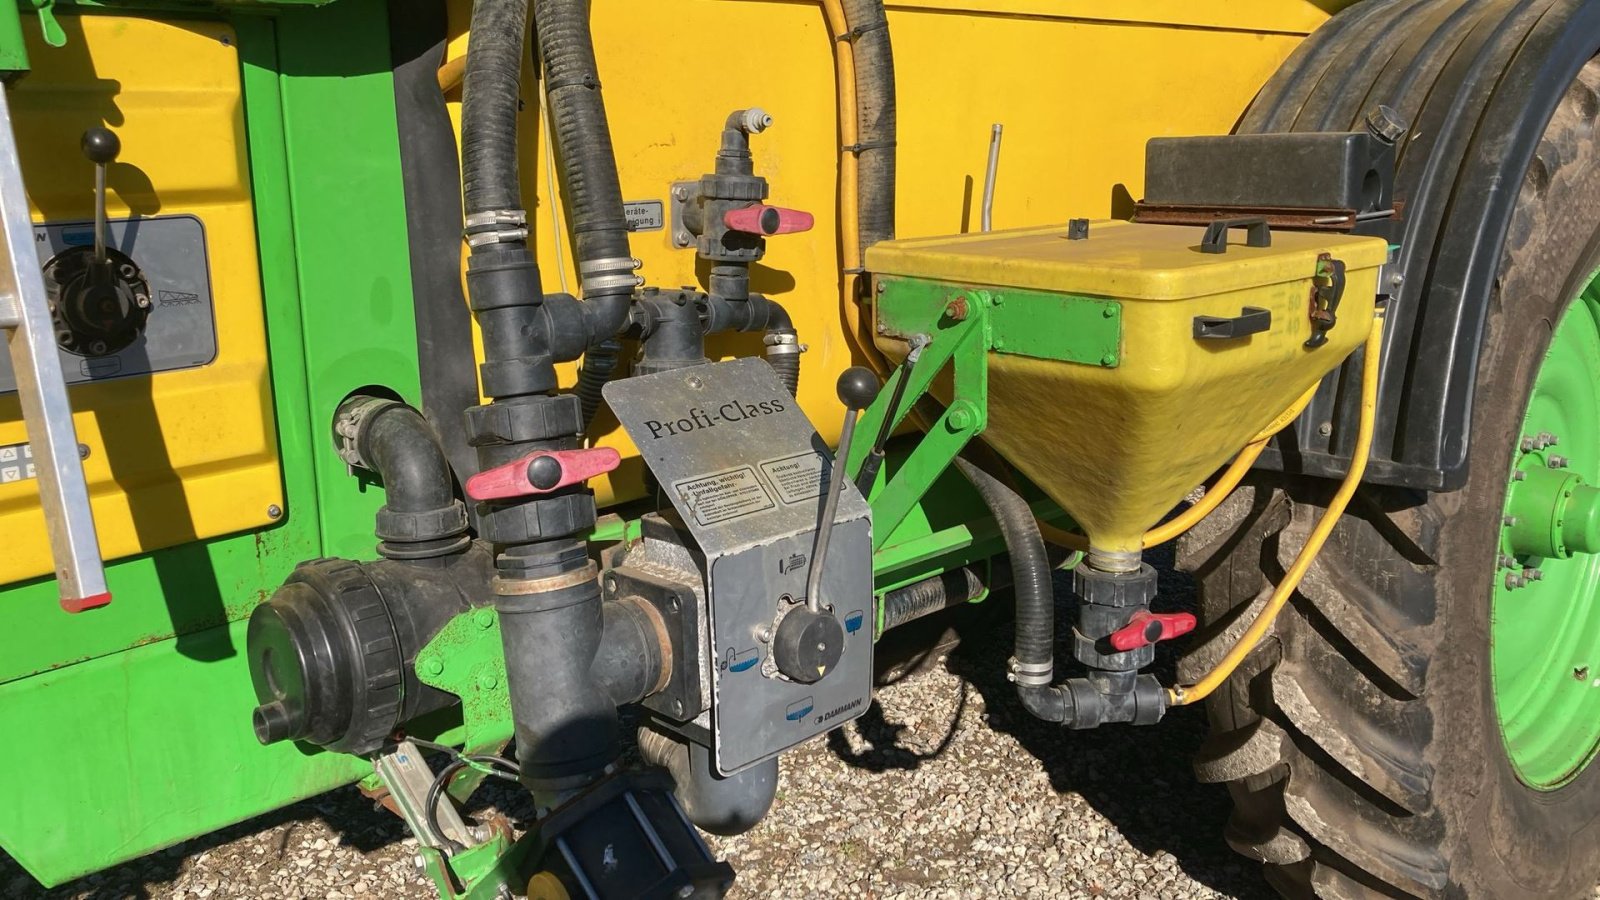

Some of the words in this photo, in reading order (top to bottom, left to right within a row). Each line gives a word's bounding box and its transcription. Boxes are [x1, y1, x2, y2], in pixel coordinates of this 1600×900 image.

[625, 207, 649, 216] eräte-
[643, 399, 785, 440] Profi-Class
[771, 462, 800, 474] Achtung!
[718, 471, 746, 483] wichtig!
[824, 697, 862, 721] DAMMANN
